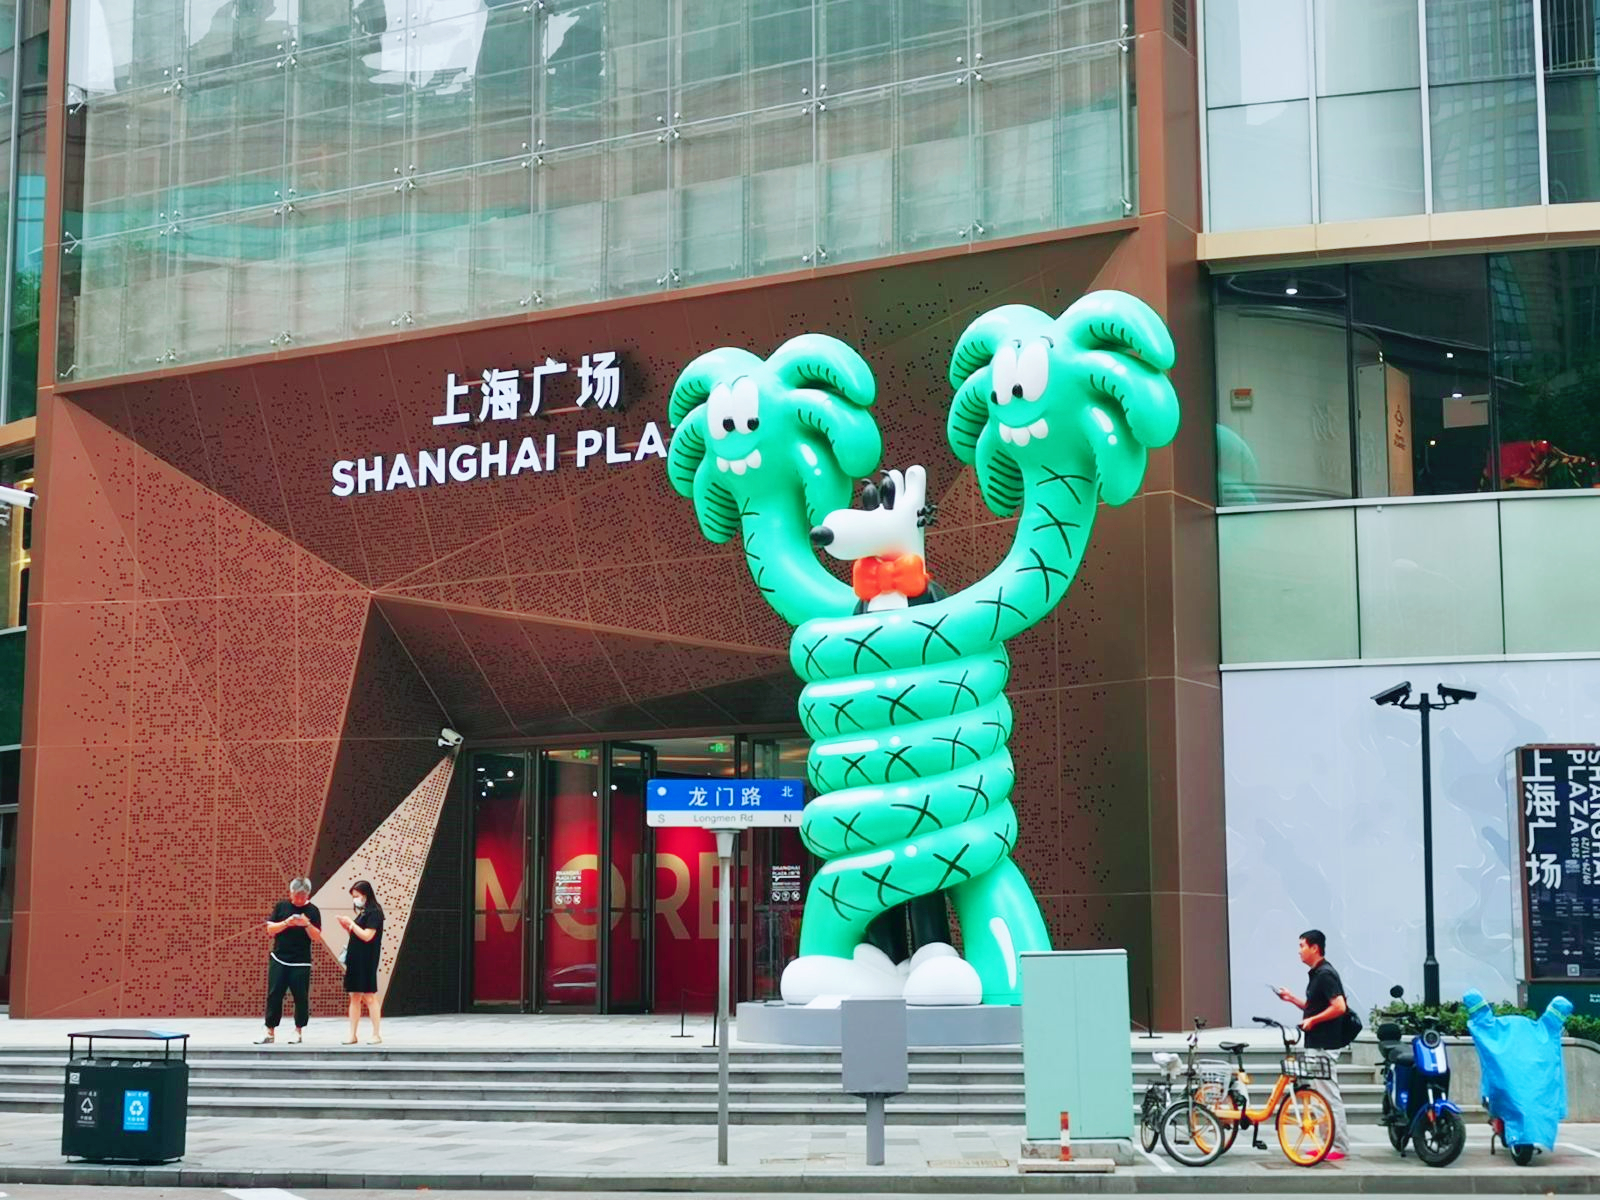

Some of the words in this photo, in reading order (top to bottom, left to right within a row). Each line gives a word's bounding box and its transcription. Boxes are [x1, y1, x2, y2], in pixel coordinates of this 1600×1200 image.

[432, 351, 621, 426] 上海广场
[332, 433, 556, 497] SHANGHAI
[688, 786, 761, 807] 龙门路
[781, 785, 794, 798] 北
[1567, 750, 1590, 834] PLAZA
[657, 814, 666, 823] S
[693, 814, 737, 824] Longmen
[740, 813, 754, 822] Rd
[783, 814, 792, 823] N
[1522, 749, 1561, 889] 上海广场
[474, 852, 748, 941] MORE
